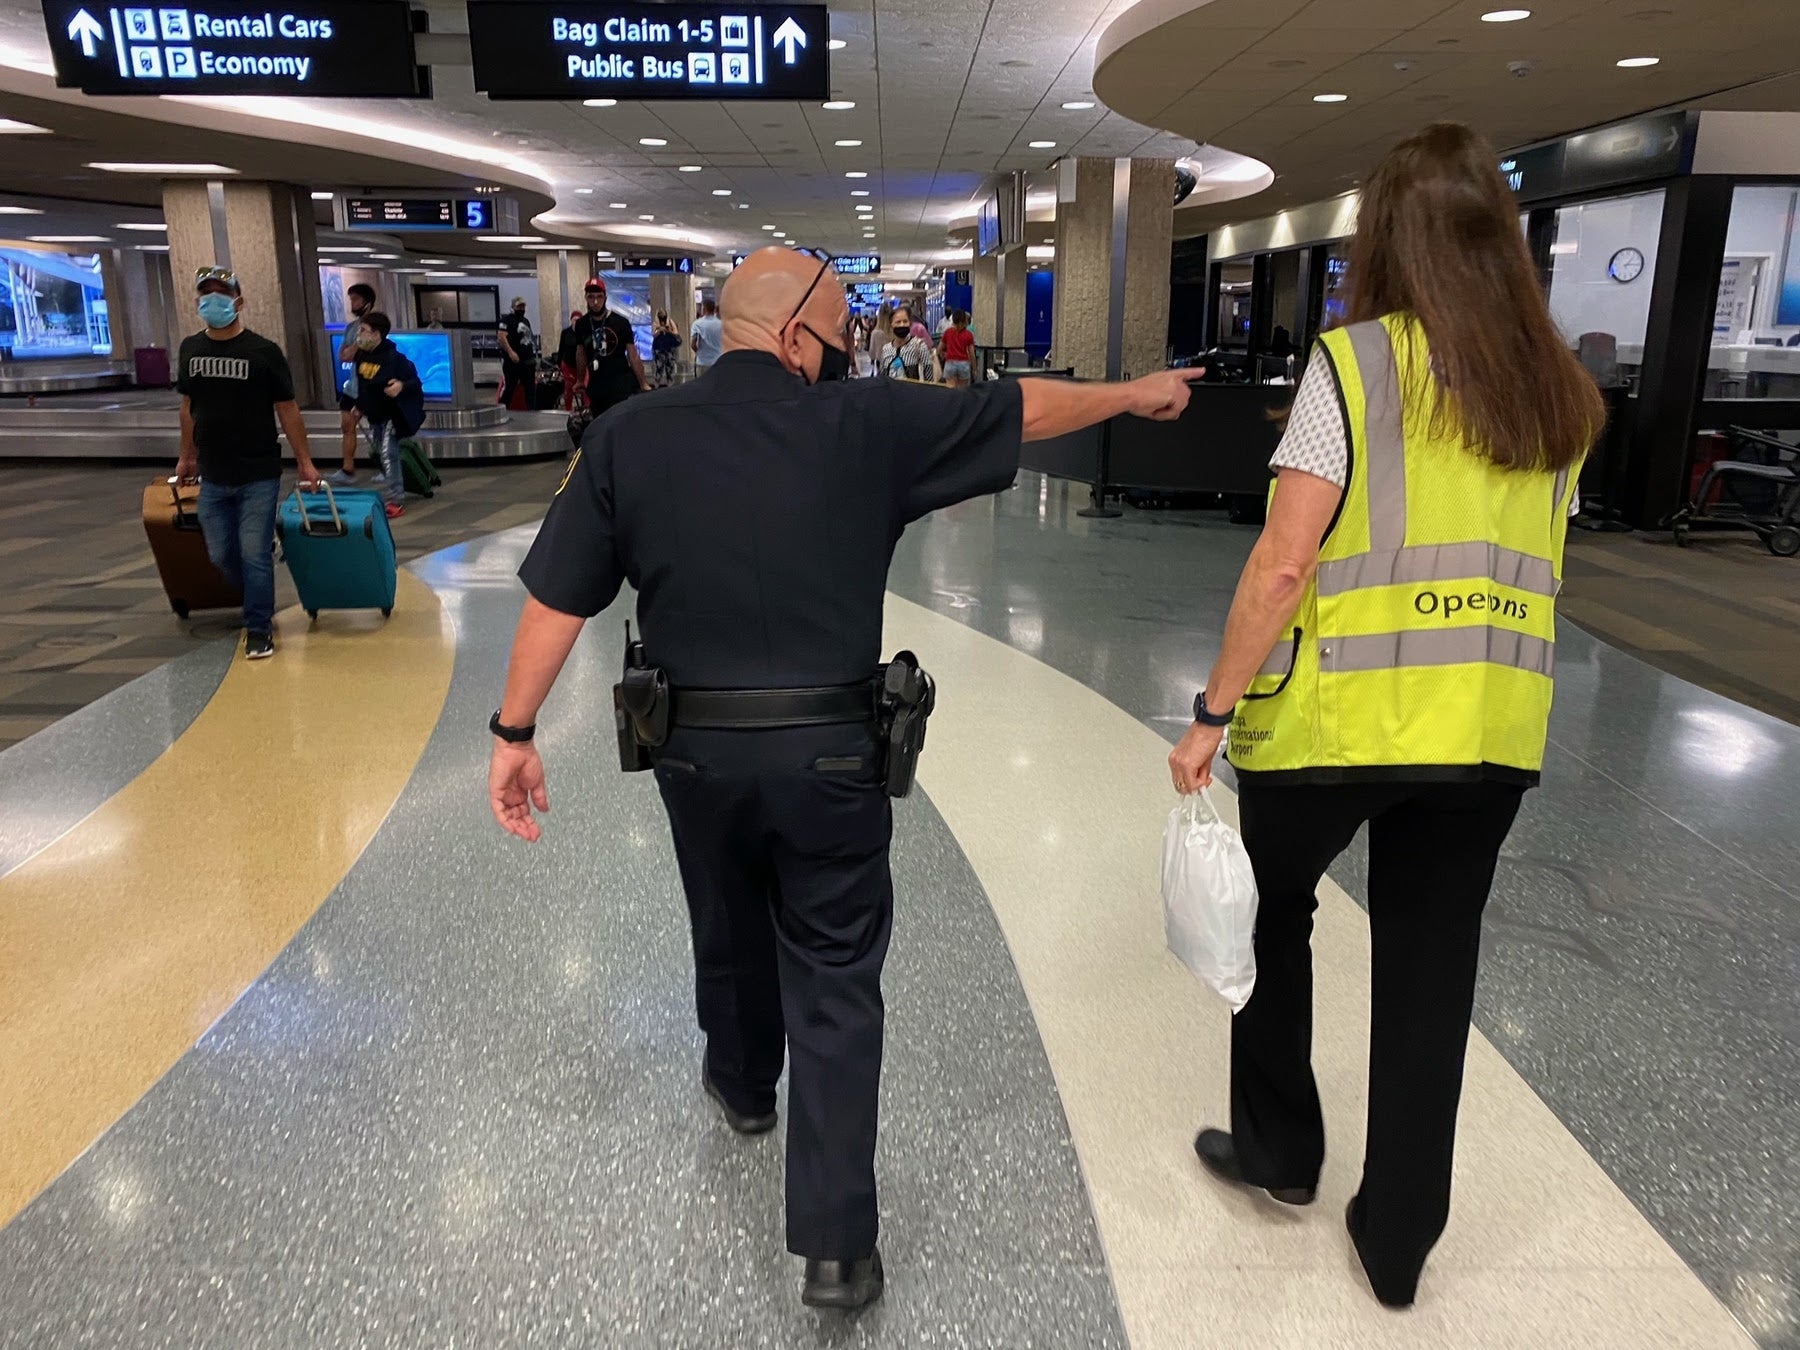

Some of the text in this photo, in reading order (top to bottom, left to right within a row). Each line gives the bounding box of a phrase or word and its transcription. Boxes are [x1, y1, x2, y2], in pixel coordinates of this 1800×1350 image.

[194, 12, 333, 39] Rental Cars
[553, 17, 714, 47] Bag Claim 1-5
[200, 51, 310, 81] Economy
[567, 53, 684, 79] Public Bus
[467, 201, 483, 228] 5
[679, 258, 690, 273] 4
